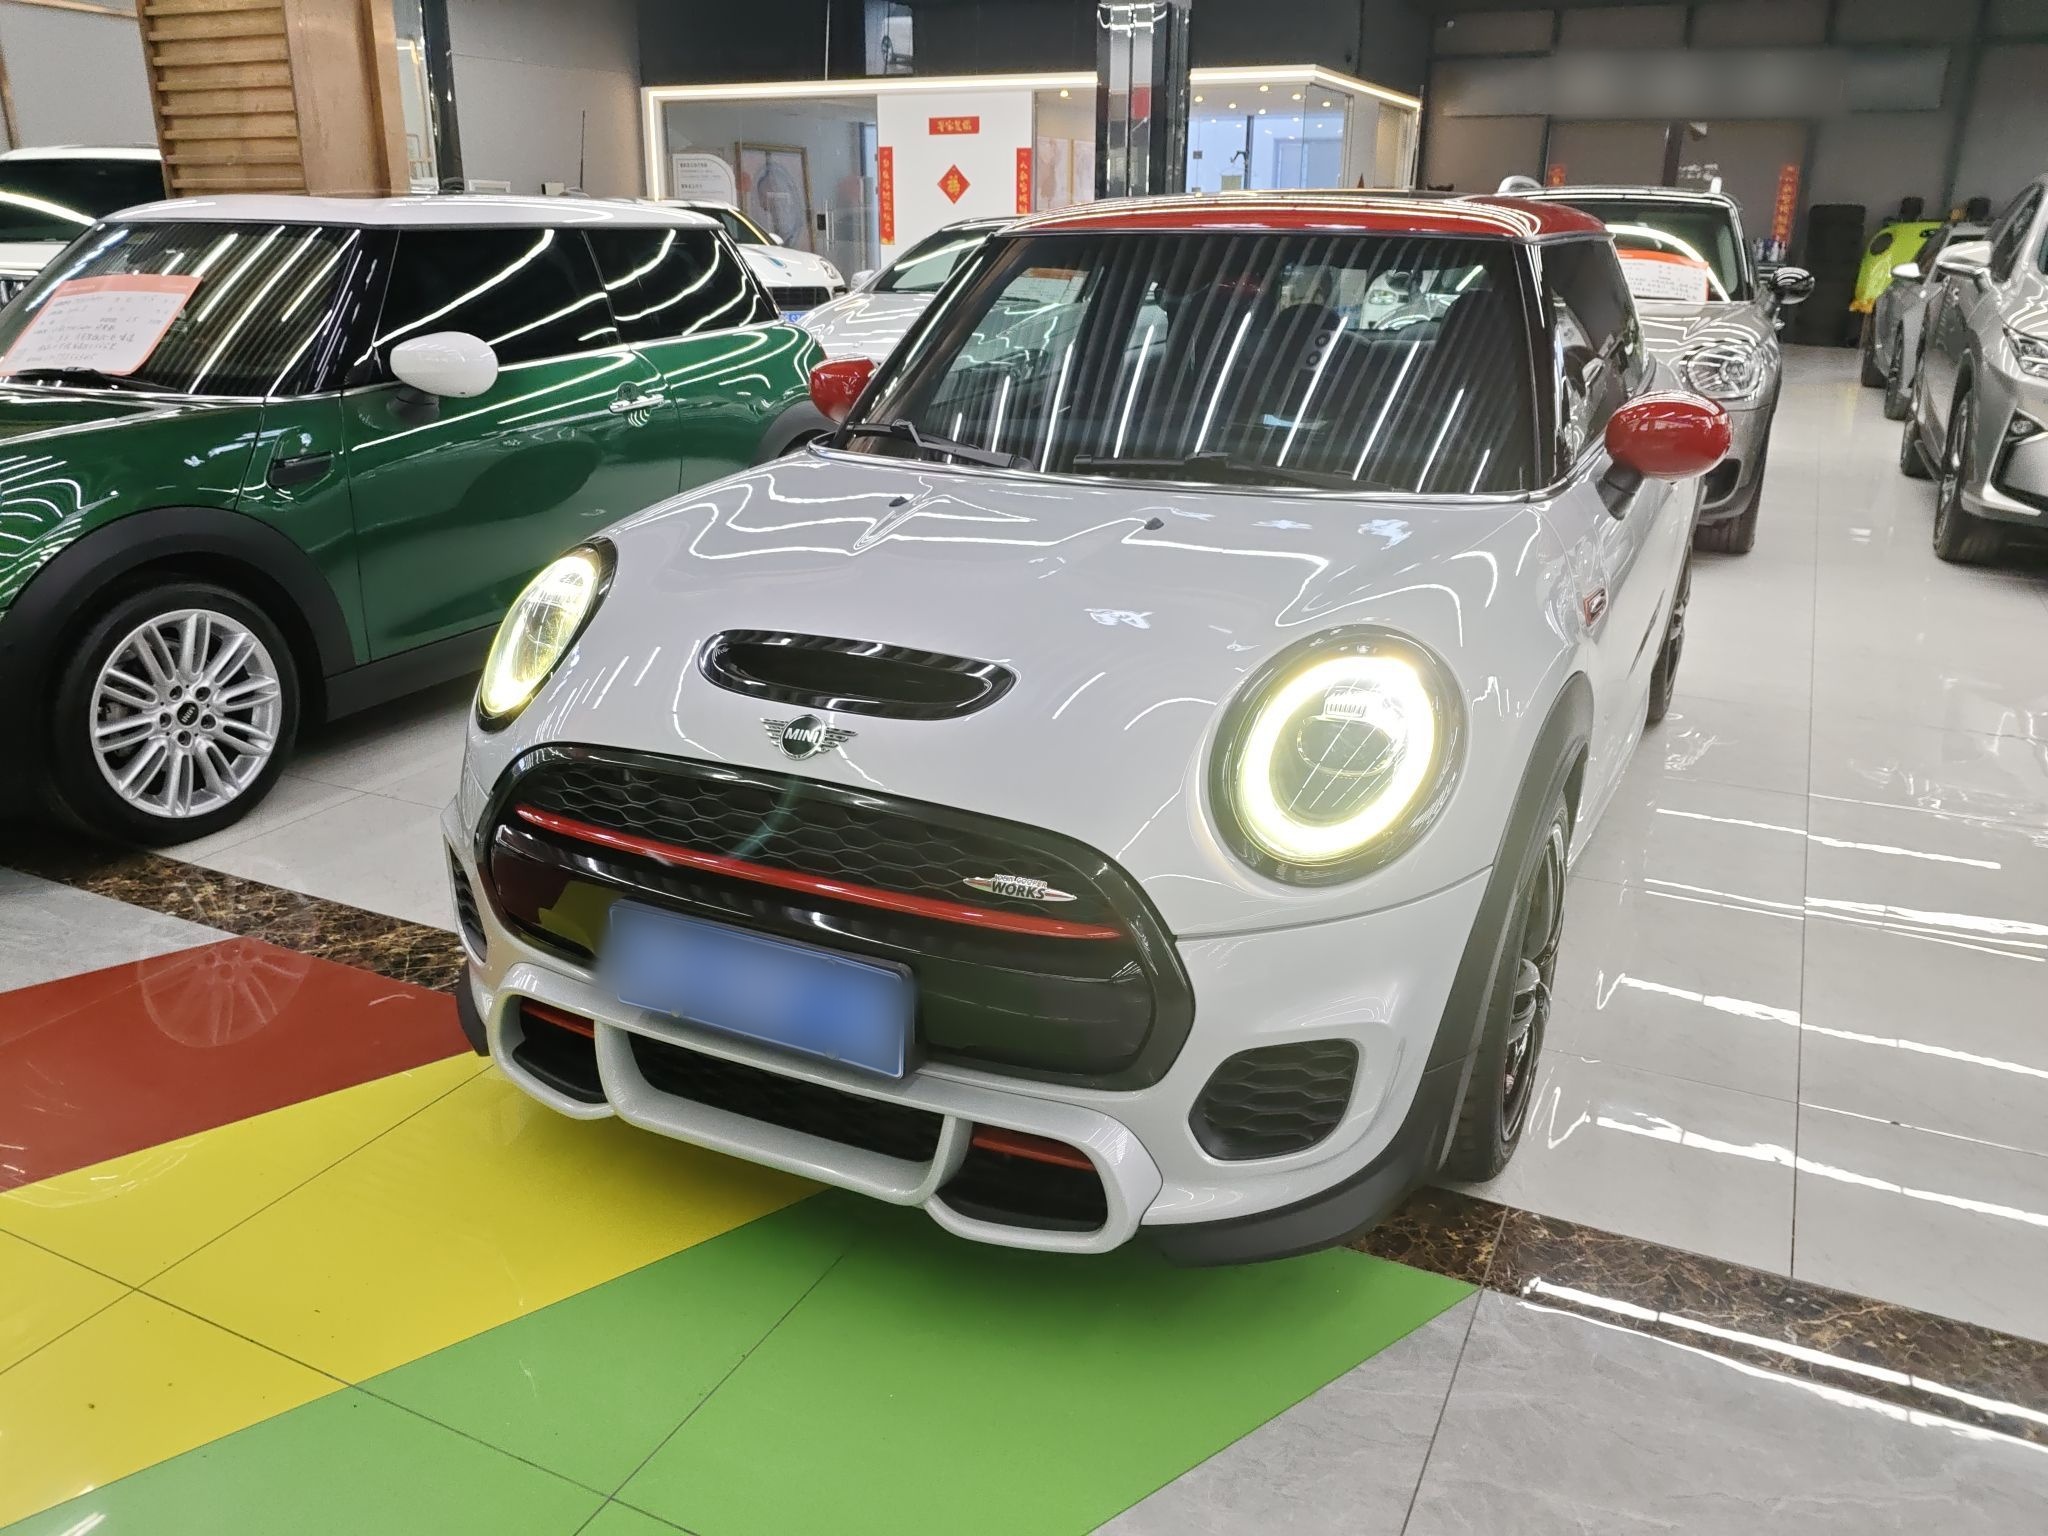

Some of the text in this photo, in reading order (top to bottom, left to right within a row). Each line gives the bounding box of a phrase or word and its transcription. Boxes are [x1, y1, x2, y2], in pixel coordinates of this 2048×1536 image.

[946, 174, 962, 195] 福
[181, 706, 196, 723] MINI
[784, 727, 821, 744] MINI
[992, 880, 1046, 899] WORKS
[1016, 876, 1048, 888] COOPER
